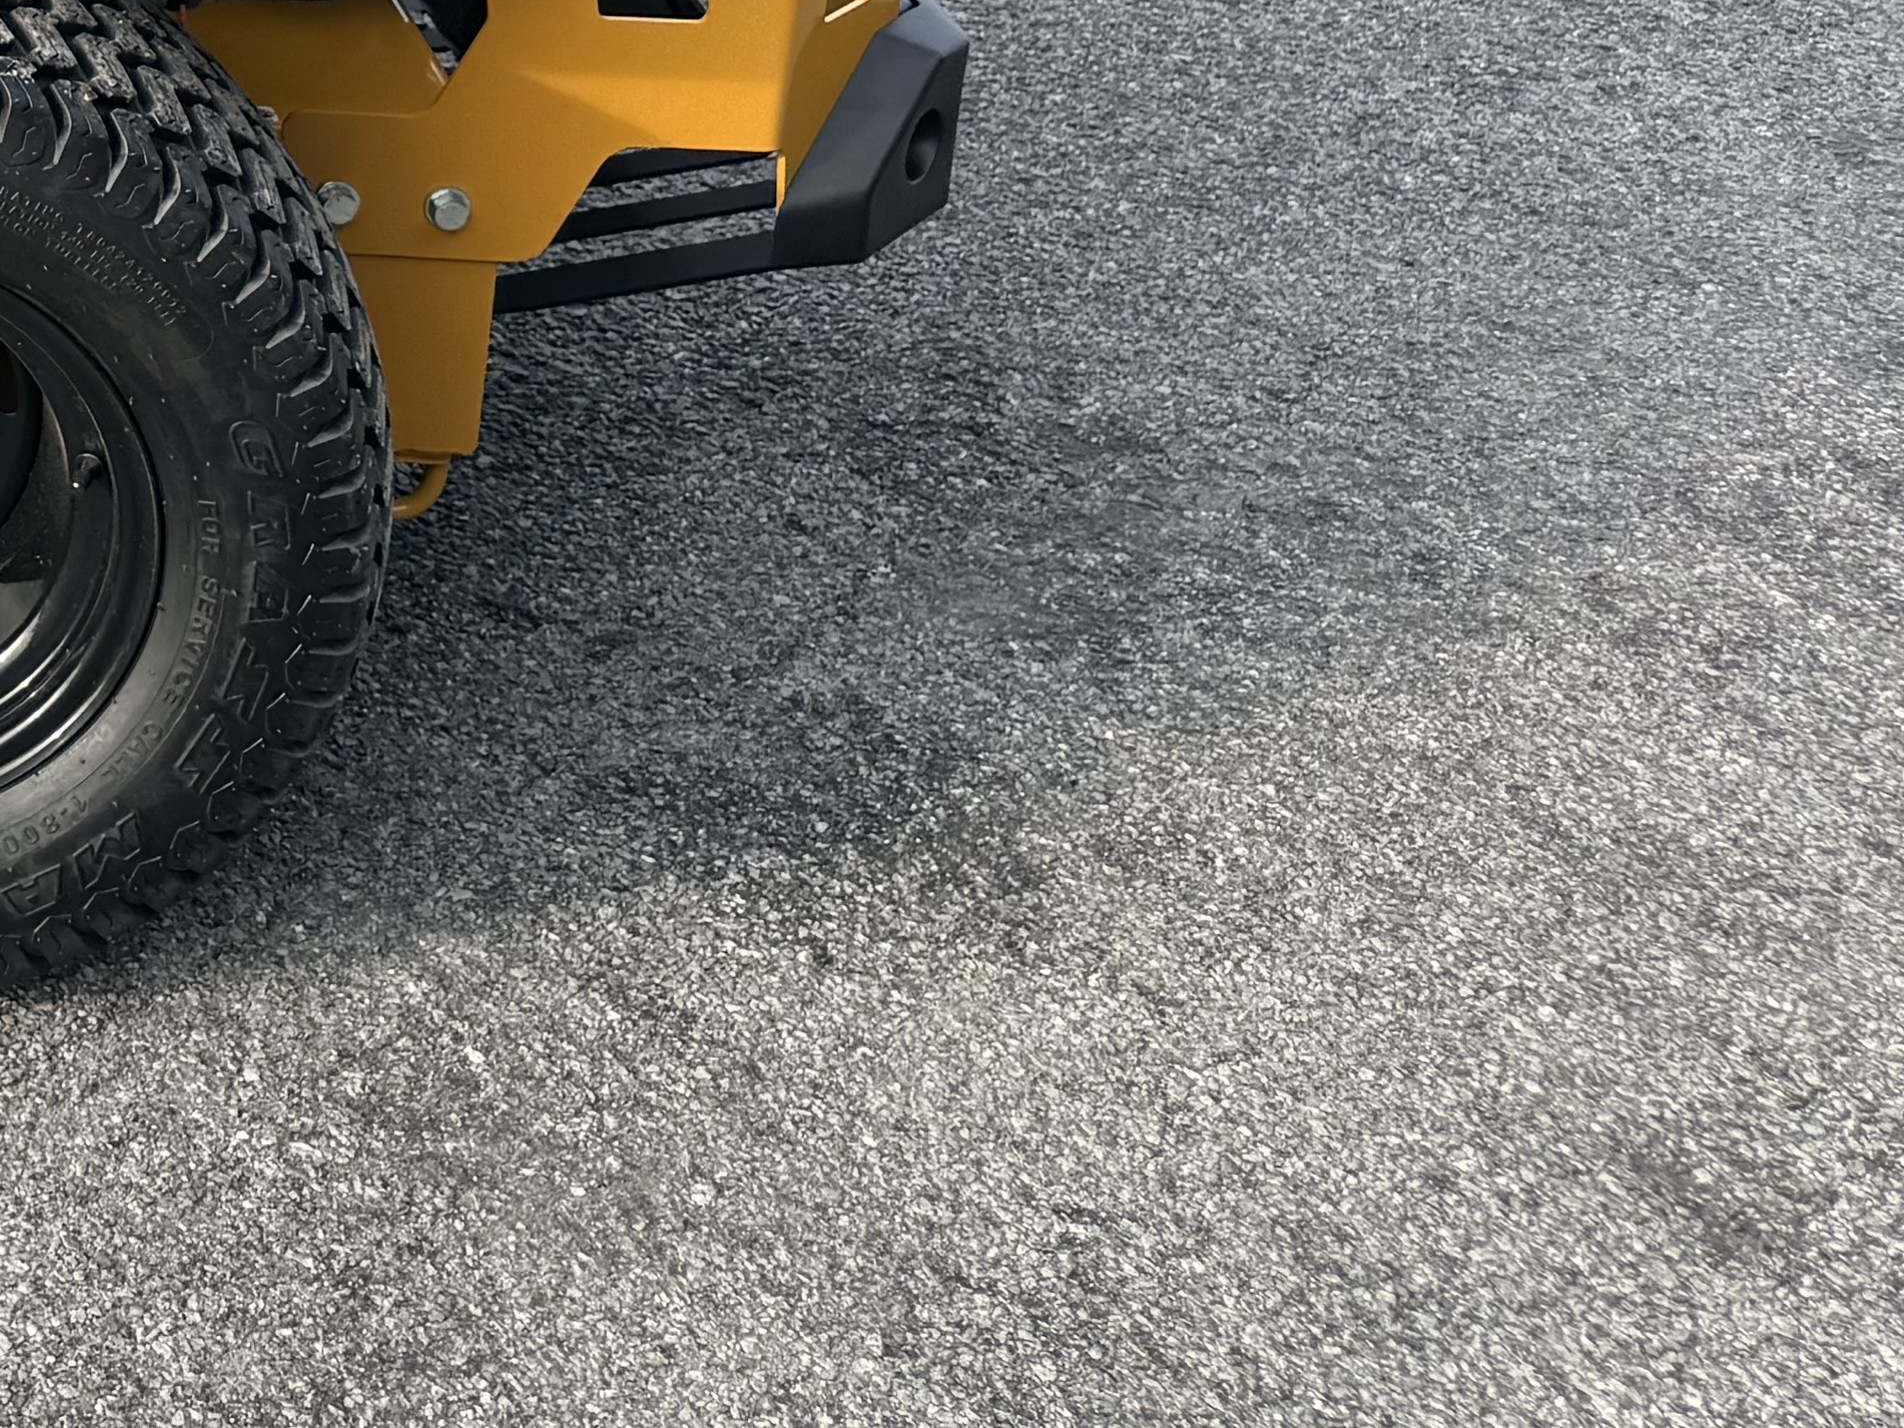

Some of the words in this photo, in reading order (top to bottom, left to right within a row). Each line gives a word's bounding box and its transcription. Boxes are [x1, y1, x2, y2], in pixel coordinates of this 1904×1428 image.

[197, 499, 222, 557] FOR
[161, 575, 222, 708] SERVICE
[176, 421, 291, 794] GRASS
